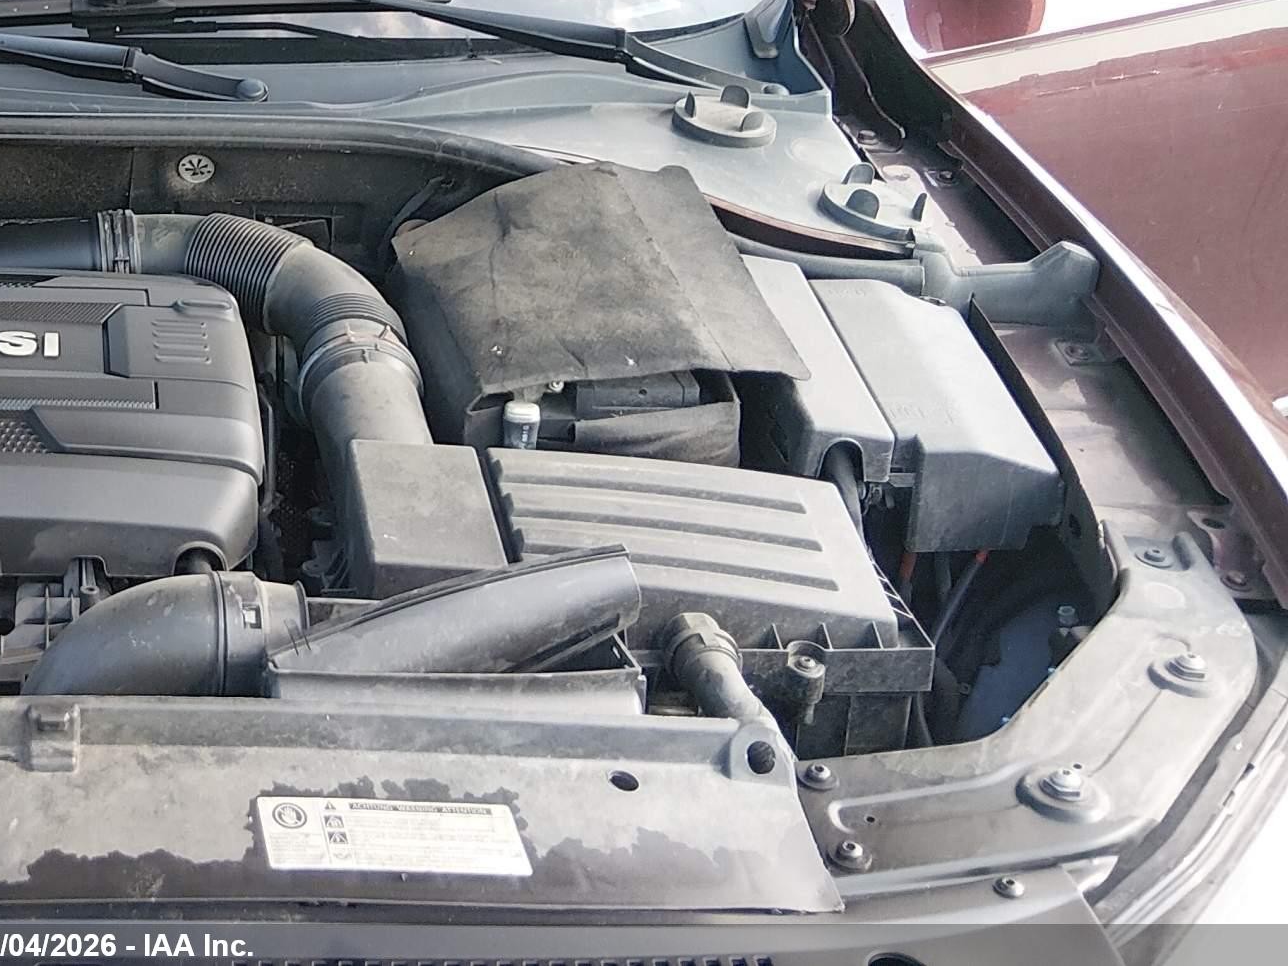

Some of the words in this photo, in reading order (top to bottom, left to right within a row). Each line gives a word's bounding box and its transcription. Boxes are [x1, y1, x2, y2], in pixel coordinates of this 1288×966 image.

[353, 803, 393, 811] ACHTUNG
[398, 804, 438, 813] WARNING
[442, 806, 488, 815] ATTENTION
